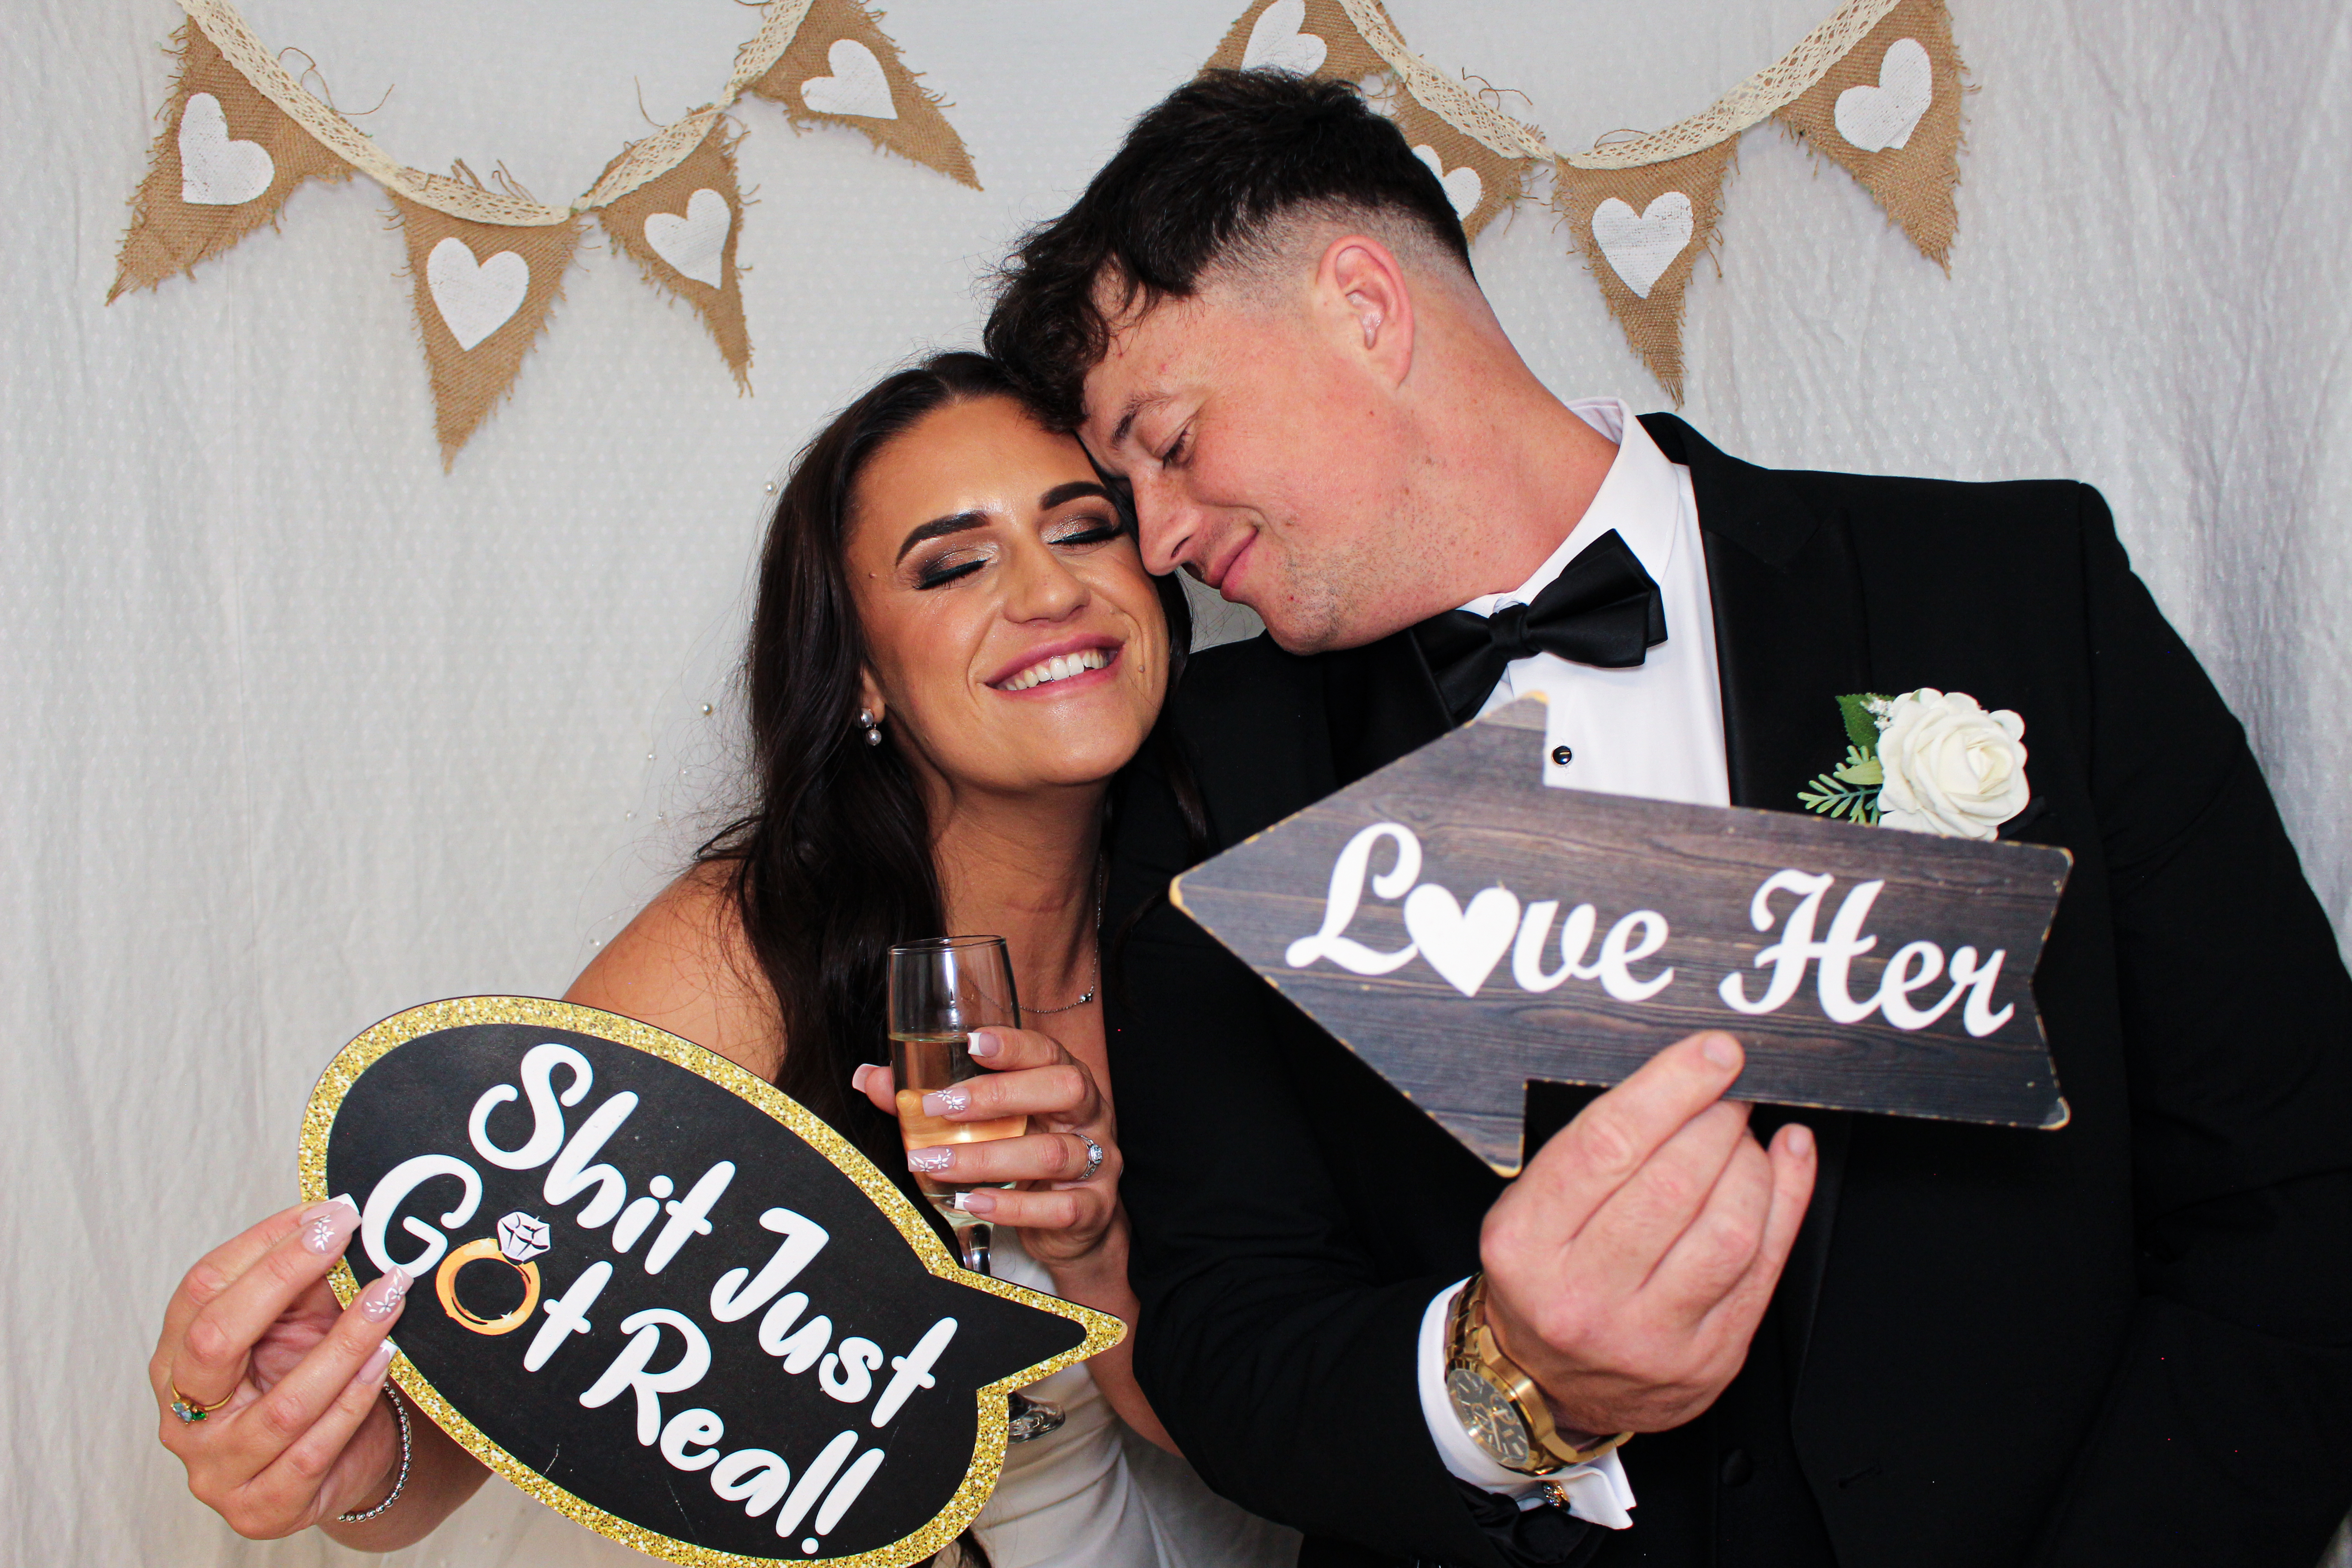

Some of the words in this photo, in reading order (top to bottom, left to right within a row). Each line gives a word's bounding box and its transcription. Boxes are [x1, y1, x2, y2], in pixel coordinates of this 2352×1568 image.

[1284, 821, 1675, 1003] Love
[1717, 868, 2014, 1037] Her
[361, 1154, 613, 1372] Got
[579, 1308, 885, 1555] Real!
[468, 1043, 735, 1275] Shit
[710, 1207, 958, 1428] Just
